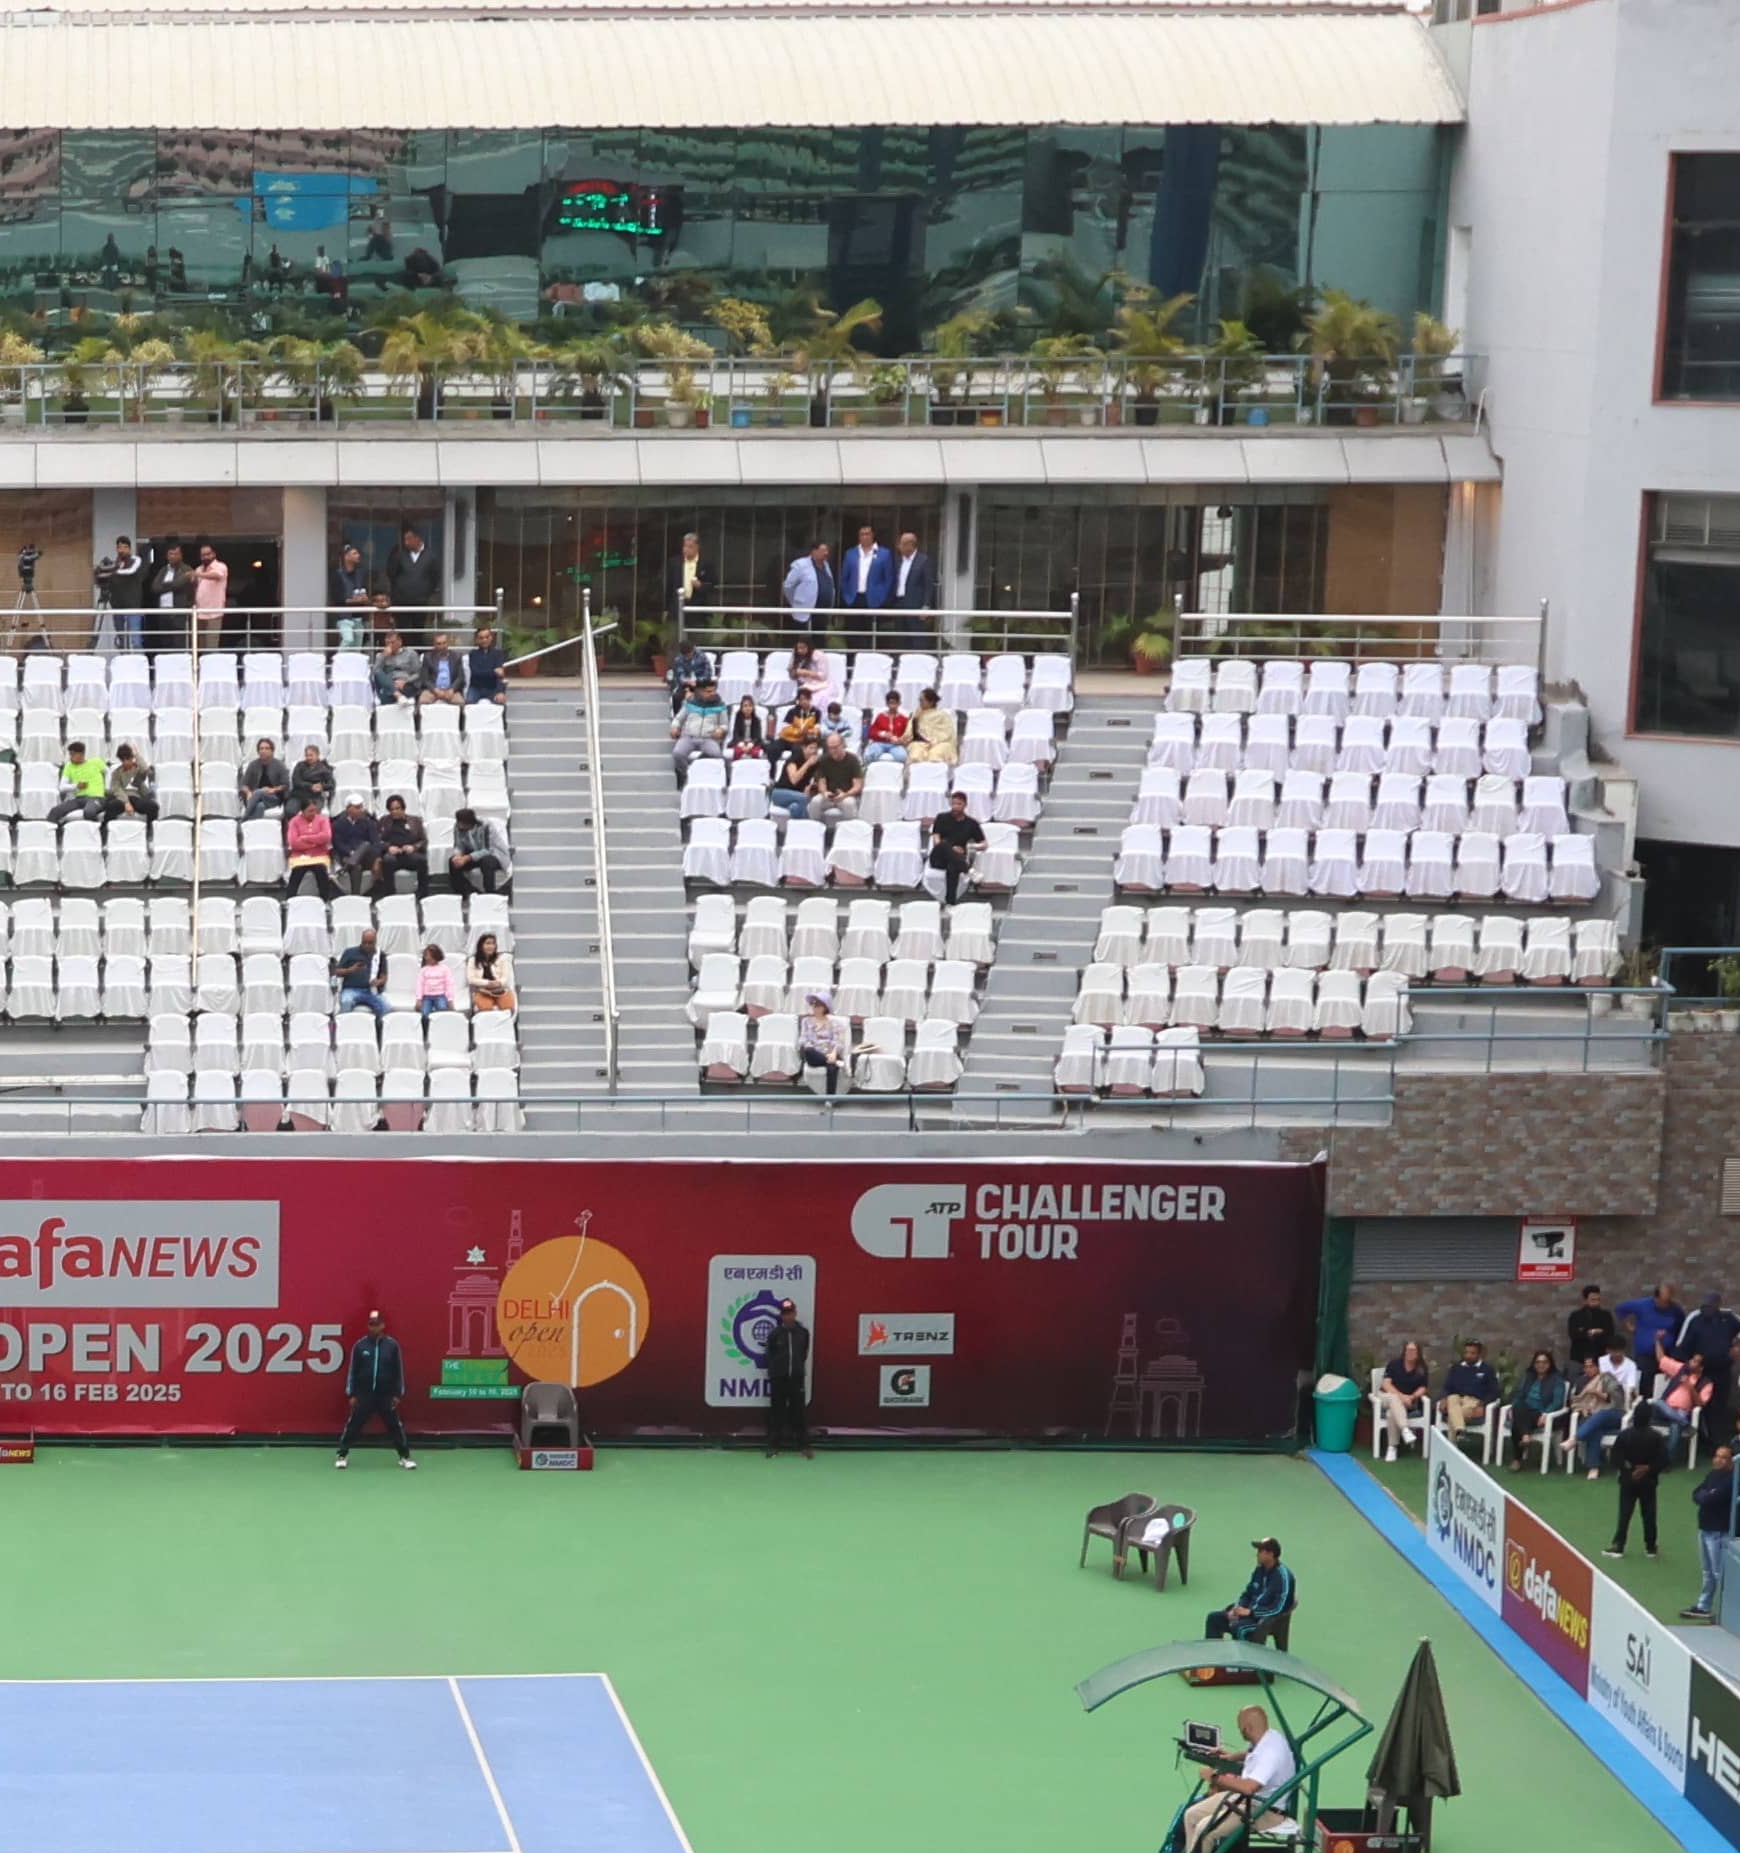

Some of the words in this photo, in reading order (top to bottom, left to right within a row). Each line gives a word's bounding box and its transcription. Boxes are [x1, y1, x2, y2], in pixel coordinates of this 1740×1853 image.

[924, 1202, 961, 1215] ATP
[975, 1184, 1226, 1222] CHALLENGER
[976, 1224, 1079, 1260] TOUR
[504, 1300, 568, 1320] DELHI
[185, 1322, 344, 1374] 2025
[893, 1332, 949, 1342] TRENZ
[1, 1383, 33, 1401] TO
[41, 1383, 67, 1402] 16
[75, 1383, 120, 1402] FEB
[126, 1383, 181, 1402] 2025
[1453, 1521, 1495, 1590] NMDC
[1523, 1557, 1588, 1648] dafaNEWS
[1625, 1632, 1652, 1688] SAI
